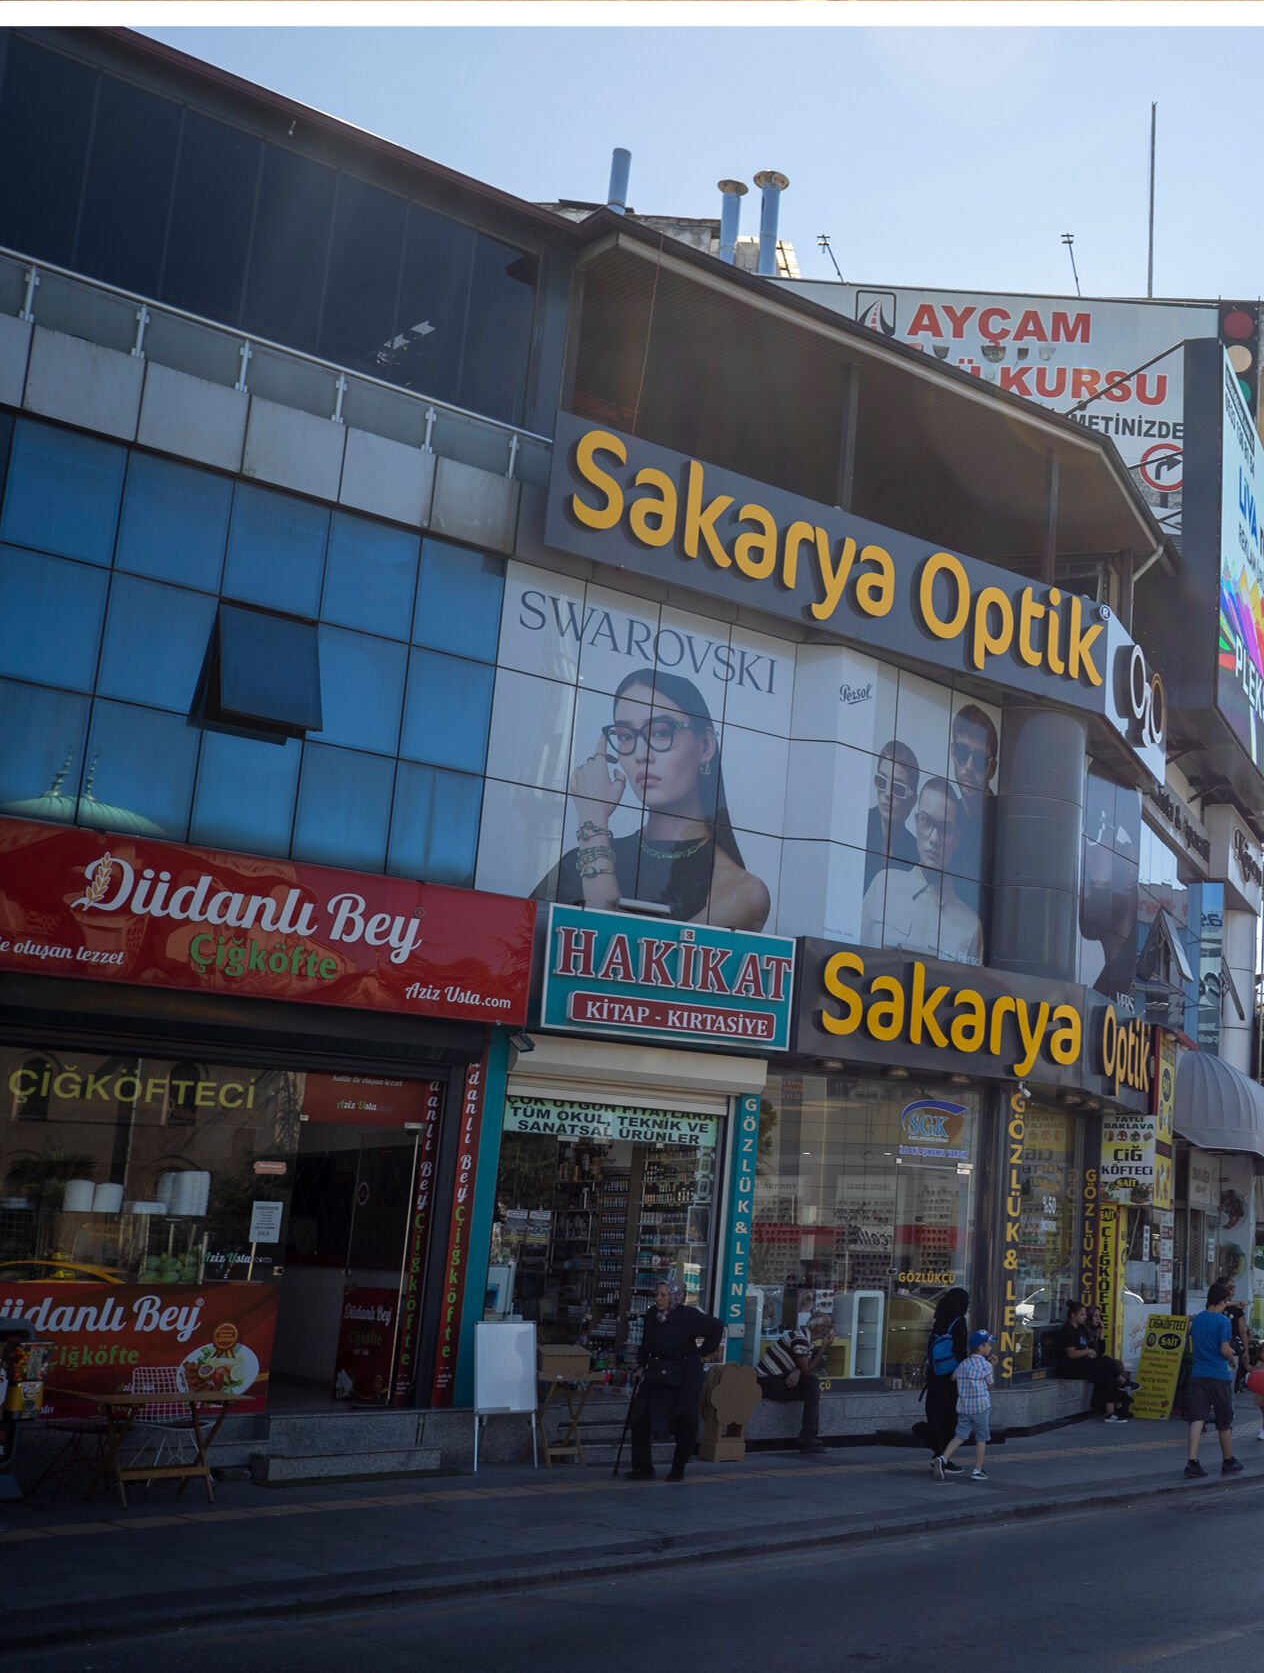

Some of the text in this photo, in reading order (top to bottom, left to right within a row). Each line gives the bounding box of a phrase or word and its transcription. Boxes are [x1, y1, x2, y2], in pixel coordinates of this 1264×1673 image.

[906, 304, 1092, 347] AYÇAM
[999, 365, 1169, 407] KURSU
[1052, 408, 1184, 439] METİNİZDE
[573, 430, 1105, 687] Sakarya Optik
[519, 590, 778, 694] SWAROVSKI
[839, 684, 873, 705] Persol
[71, 852, 422, 964] Düdanlı Bey
[14, 939, 125, 965] oluşan lezzet
[190, 934, 338, 980] Çiğköfte
[552, 926, 793, 1002] HAKİKAT
[405, 982, 512, 1009] Aziz Usta.com
[586, 998, 650, 1023] KİTAP
[667, 1010, 768, 1037] KIRTASİYE
[822, 951, 1151, 1096] Sakarya Optik
[9, 1064, 257, 1109] ÇİĞKÖFTECİ
[336, 1099, 356, 1111] Aziz
[510, 1105, 709, 1133] TÜM OKUL, TEKNİK VE
[518, 1120, 700, 1144] SANATSAL ÜRÜNLER
[908, 1113, 949, 1137] SGK
[1006, 1092, 1026, 1242] GÖZLÜK
[1101, 1163, 1153, 1176] KÖFTECİ
[1113, 1145, 1142, 1165] ÇİĞ
[417, 1162, 433, 1211] Bey
[457, 1154, 472, 1204] Bey
[1116, 1178, 1137, 1188] SAİT
[201, 1252, 226, 1263] Aziz
[1081, 1169, 1097, 1307] GÖZLÜKÇÜ
[401, 1212, 425, 1365] Çiğköfte
[441, 1206, 465, 1359] Çiğköfte
[898, 1269, 956, 1284] GÖZLÜKÇÜ
[0, 1295, 202, 1342] üdanlı Bey
[376, 1305, 393, 1326] Bey
[1160, 1335, 1178, 1347] SAİT
